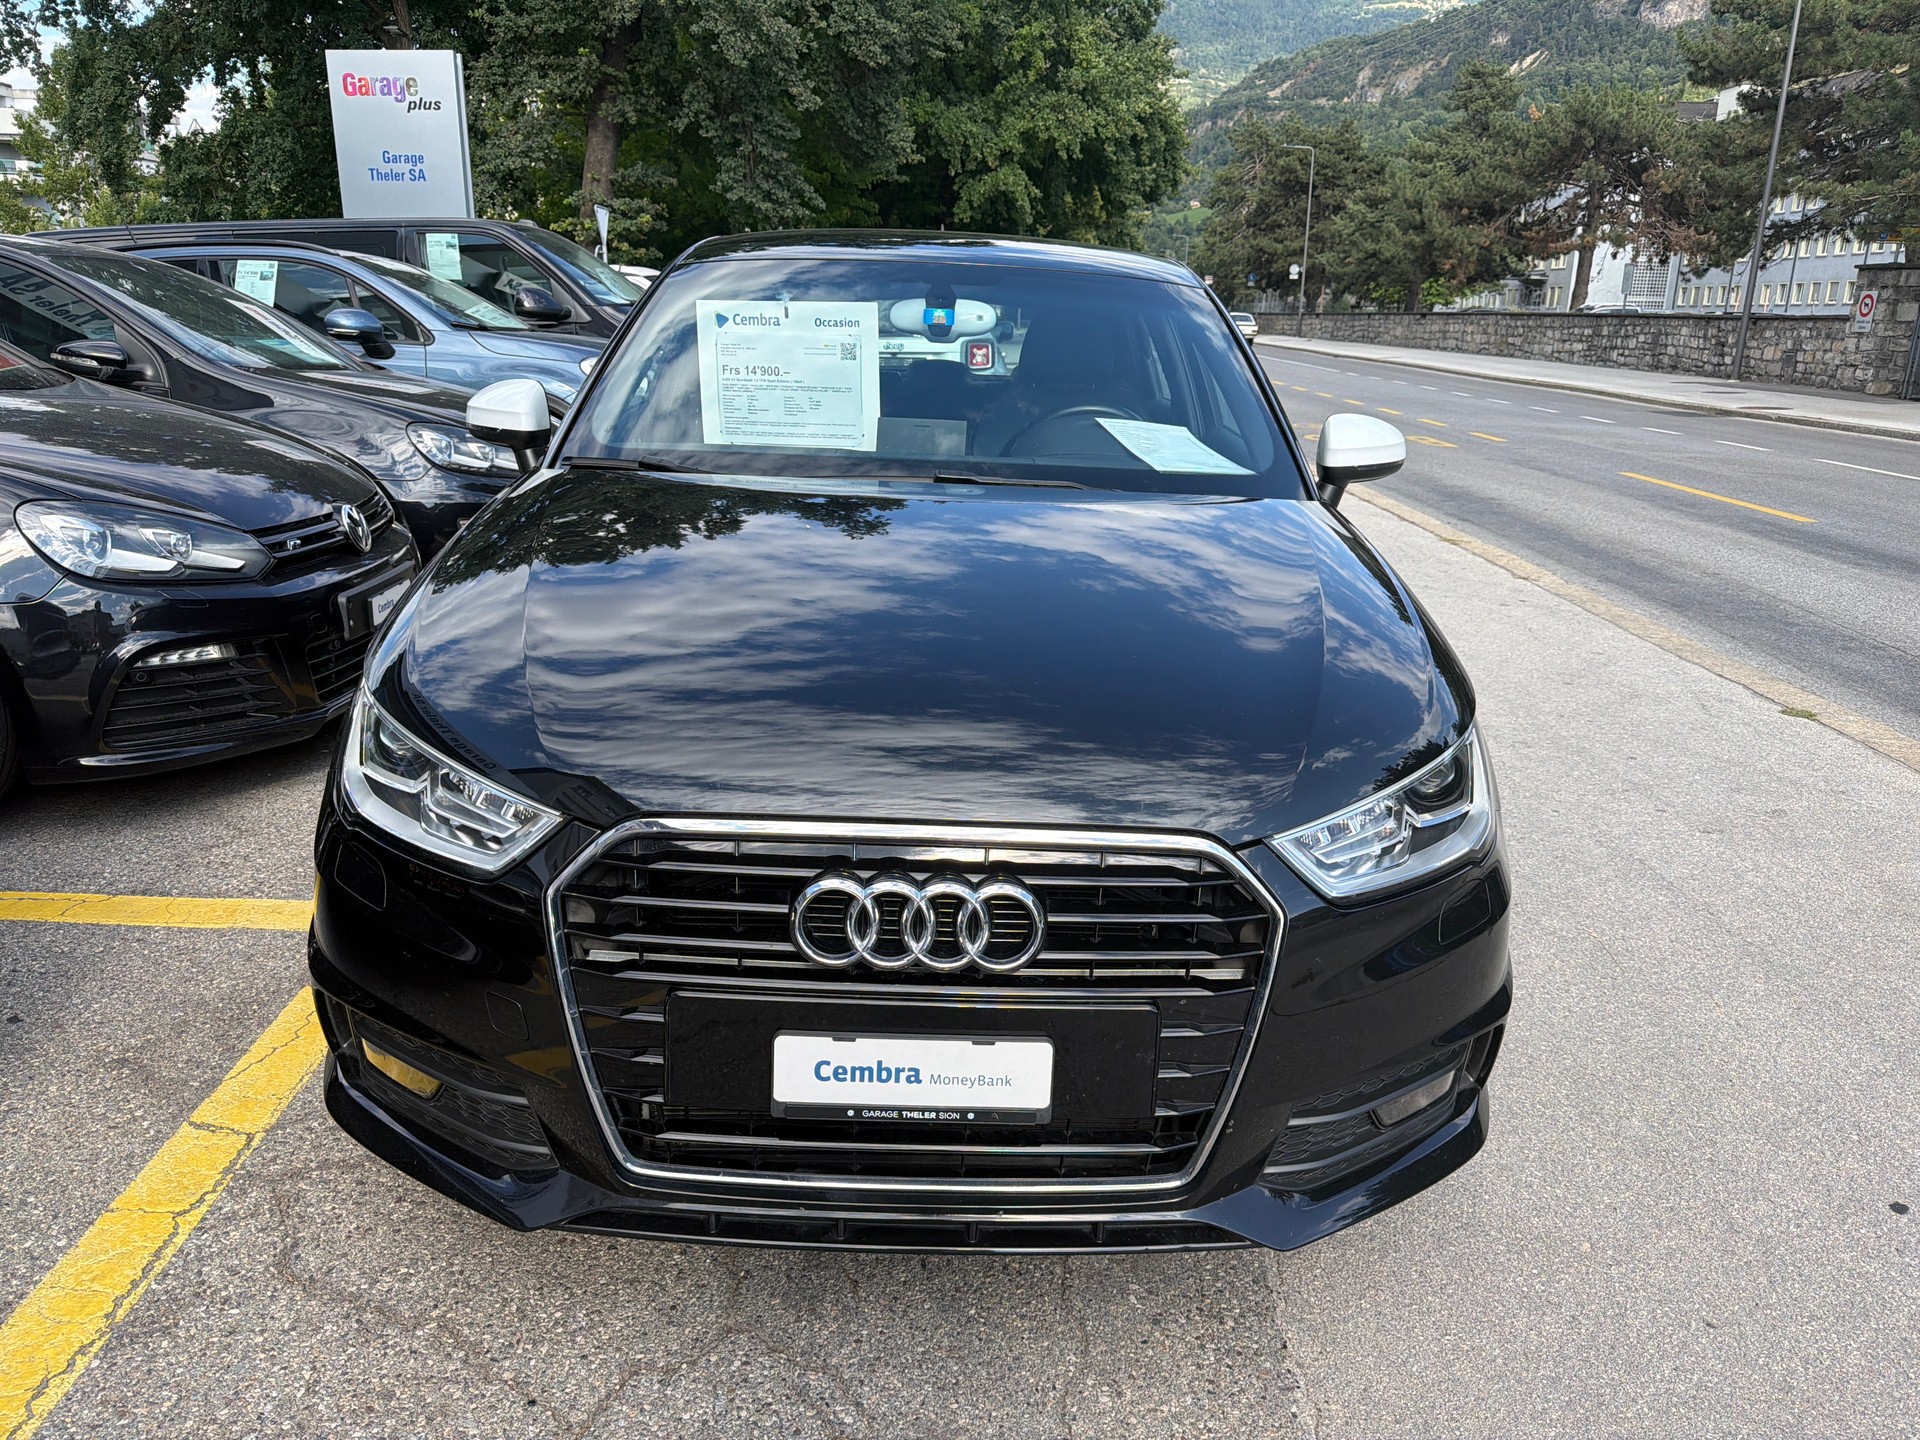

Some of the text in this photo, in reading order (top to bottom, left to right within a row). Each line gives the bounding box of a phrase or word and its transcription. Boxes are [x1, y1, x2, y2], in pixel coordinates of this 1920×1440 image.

[342, 72, 418, 103] Garage
[407, 97, 442, 113] plus
[382, 150, 424, 167] Garage
[368, 167, 427, 182] Theler SA
[732, 313, 781, 327] Cembra
[814, 317, 860, 328] Occasion
[722, 364, 741, 376] Frs
[814, 1060, 1013, 1089] Cembra MoneyBank
[862, 1110, 960, 1120] GARAGE THELER SION
